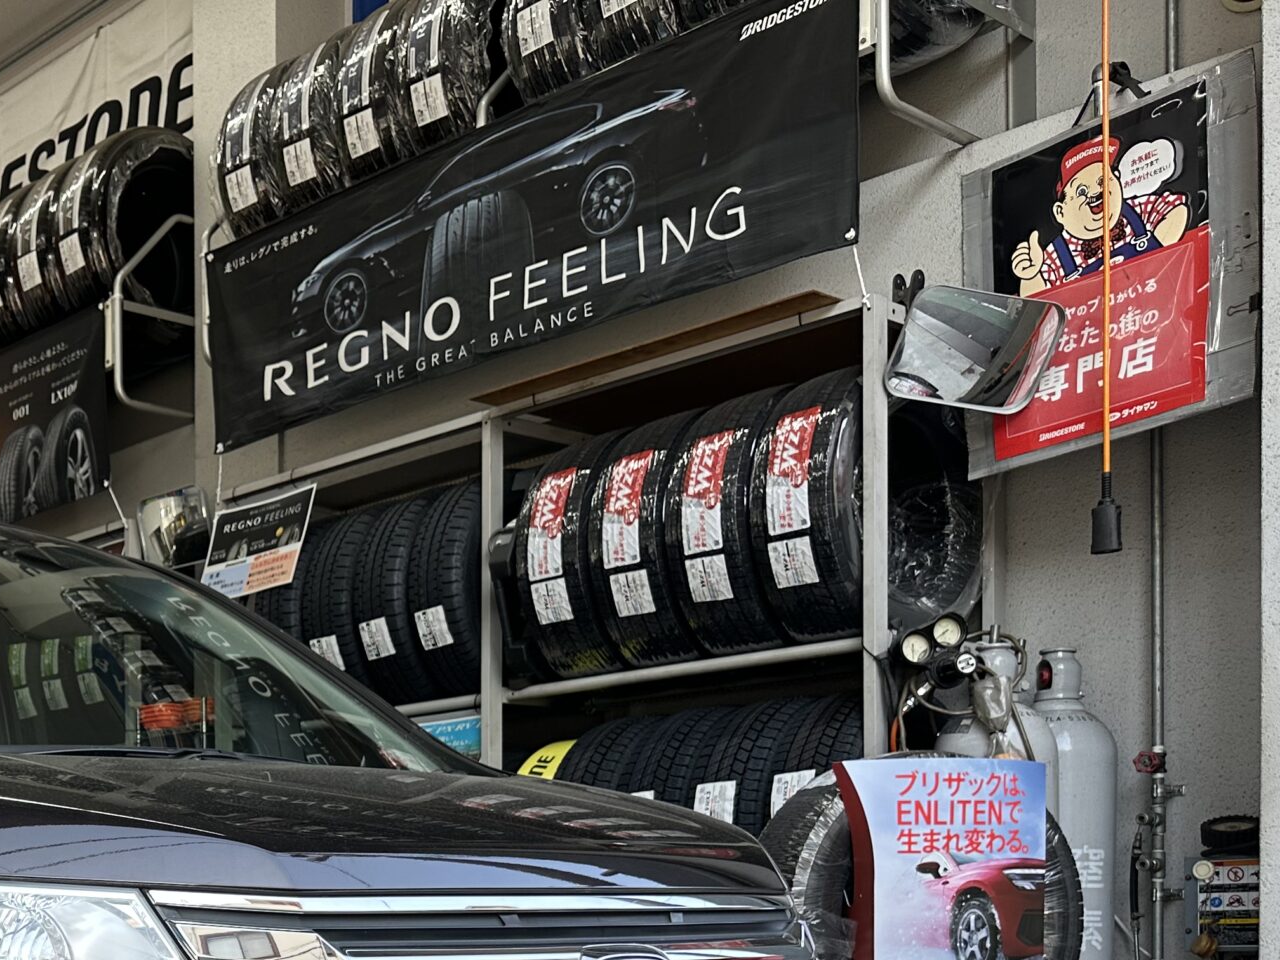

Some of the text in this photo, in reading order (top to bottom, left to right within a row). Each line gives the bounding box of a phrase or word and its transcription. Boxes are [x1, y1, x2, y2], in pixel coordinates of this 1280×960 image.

[1130, 149, 1158, 167] お気軽に
[1131, 158, 1159, 175] スタッフまで
[263, 186, 747, 401] REGNO FEELING
[375, 301, 595, 387] THE GREA BALANCE
[1034, 337, 1157, 402] 専門店
[12, 404, 30, 421] 001
[1120, 400, 1158, 419] タイヤマン
[1038, 422, 1086, 442] BRIDGESTONE
[222, 517, 262, 534] REGNO
[263, 503, 302, 523] FEELING
[895, 769, 1027, 797] ブリザックは、
[897, 800, 1023, 826] ENLITENで
[896, 828, 1029, 854] 生まれ変わる。
